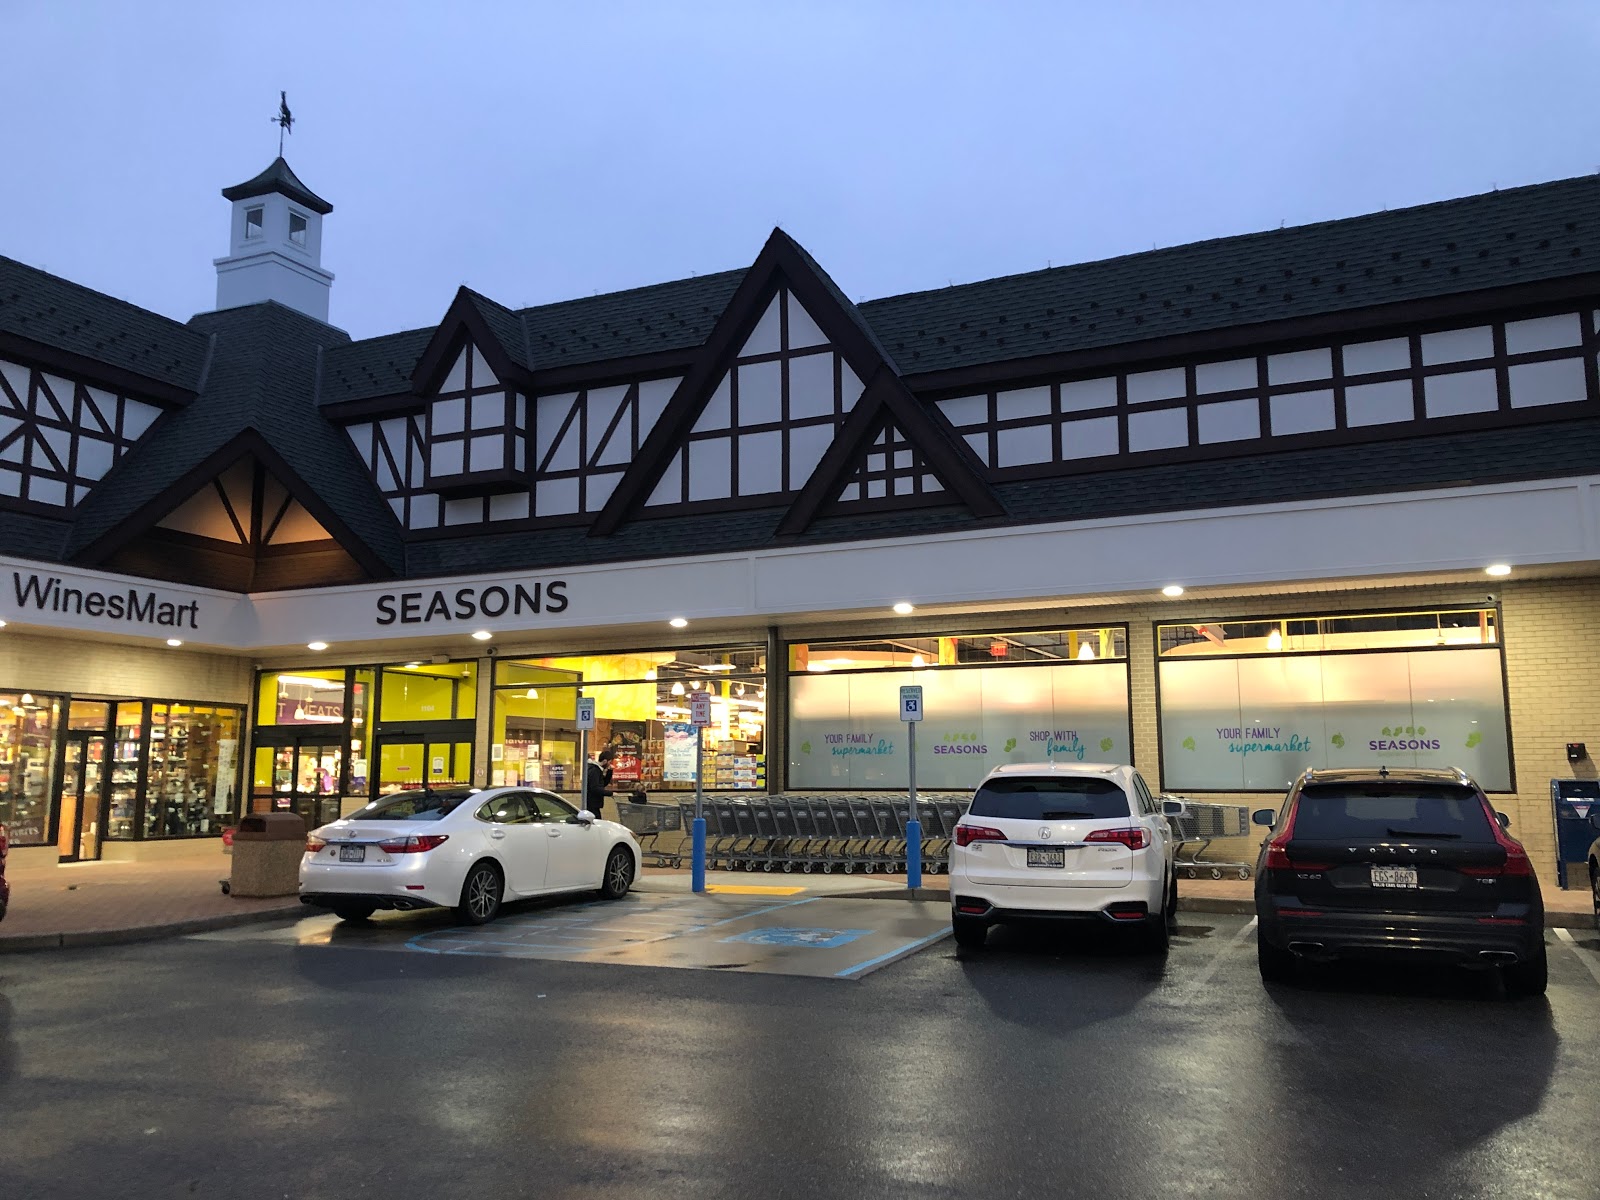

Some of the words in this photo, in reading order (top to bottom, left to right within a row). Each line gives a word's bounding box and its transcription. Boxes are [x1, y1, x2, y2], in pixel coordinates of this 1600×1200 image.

[13, 572, 199, 629] WinesMart
[376, 580, 569, 625] SEASONS
[824, 734, 844, 744] YOUR
[846, 733, 874, 744] FAMILY
[1029, 730, 1050, 741] SHOP
[1053, 730, 1077, 741] WITH
[1216, 728, 1242, 739] YOUR
[1245, 727, 1280, 739] FAMILY
[831, 739, 894, 759] supermarket
[933, 744, 988, 755] SEASONS
[1047, 737, 1087, 760] family
[1228, 733, 1311, 757] supermarket
[1369, 739, 1441, 751] SEASONS
